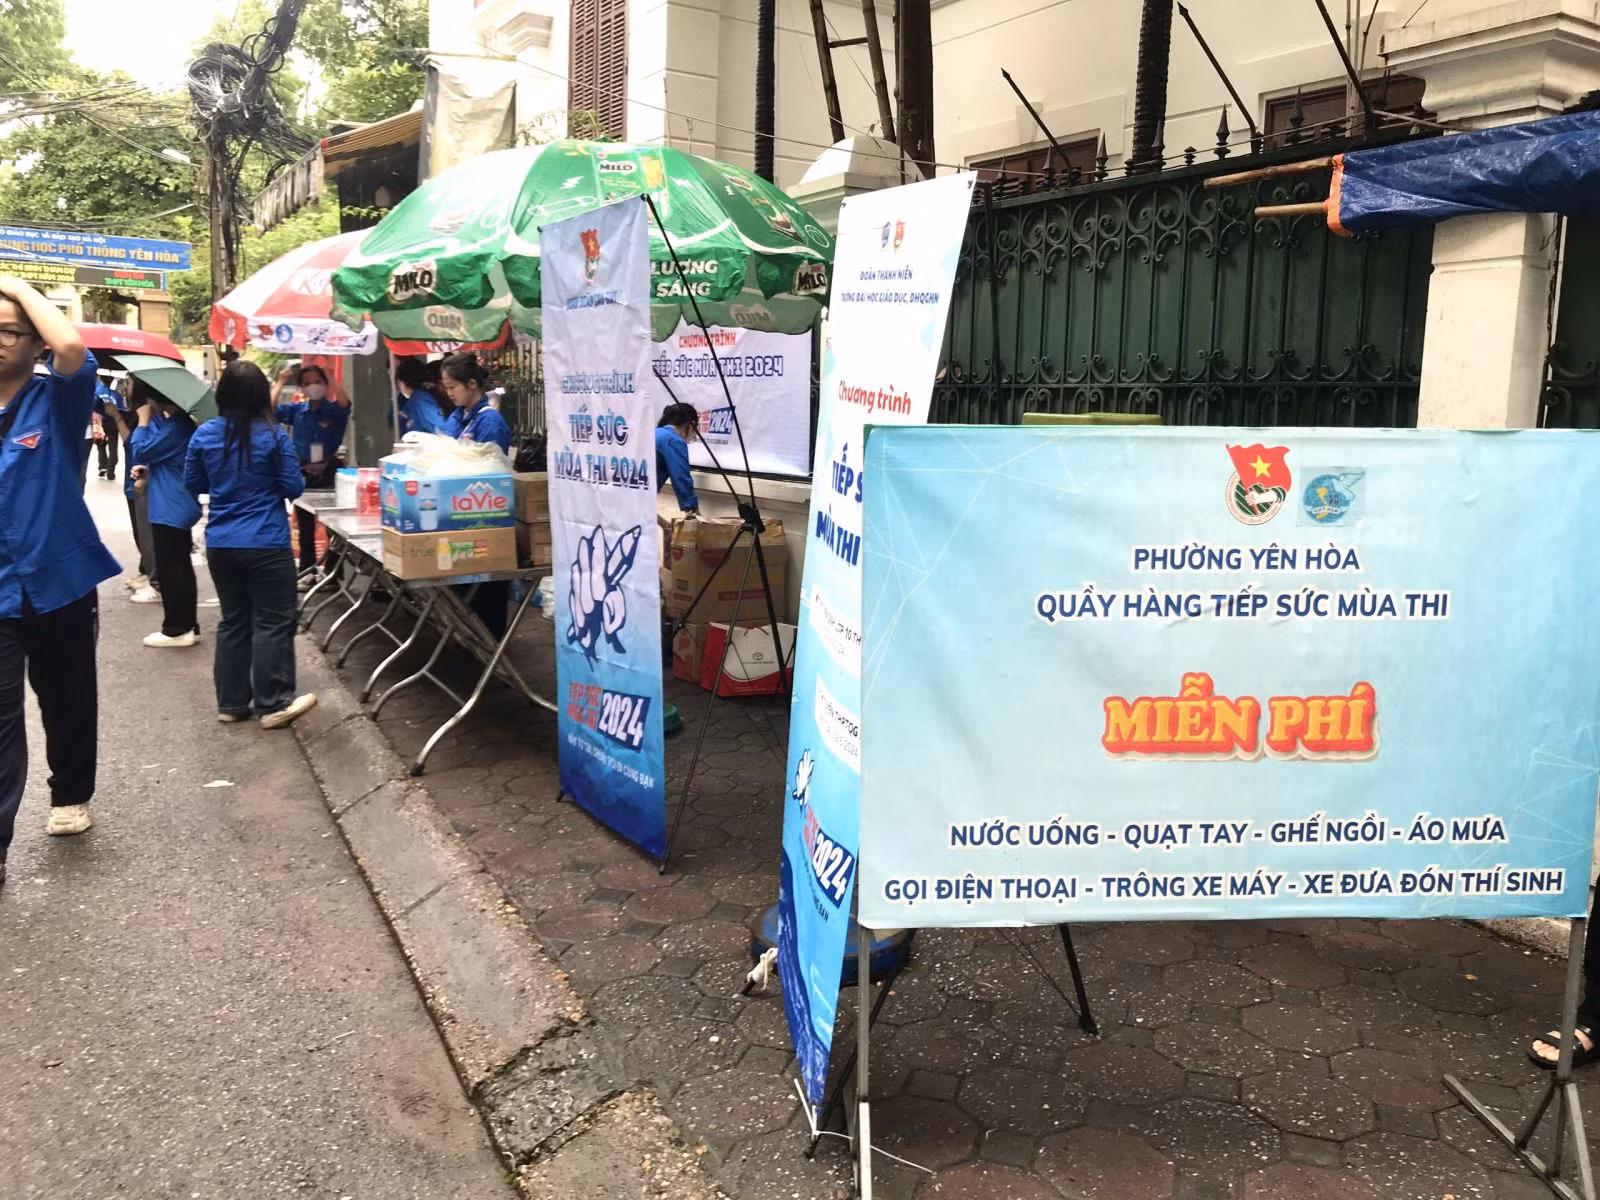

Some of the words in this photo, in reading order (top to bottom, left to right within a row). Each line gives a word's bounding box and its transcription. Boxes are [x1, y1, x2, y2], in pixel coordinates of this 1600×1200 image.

[31, 241, 57, 253] HỌC
[86, 244, 126, 259] THÔNG
[129, 247, 153, 261] YÊN
[155, 249, 179, 263] HÒA
[797, 272, 826, 291] MILO
[877, 269, 897, 280] THANH
[673, 353, 693, 378] SỨC
[694, 353, 717, 377] MÙA
[718, 356, 742, 377] THI
[745, 355, 784, 377] 2024
[838, 379, 875, 414] Chương
[877, 384, 912, 415] trình
[569, 403, 593, 443] TIẾP
[596, 407, 628, 446] SỨC
[554, 445, 584, 482] MÙA
[585, 454, 608, 485] THI
[611, 456, 649, 490] 2024
[832, 441, 854, 496] TIẾP
[816, 502, 835, 552] MÙA
[835, 525, 861, 566] THI
[1134, 543, 1242, 570] PHƯỜNG
[1249, 543, 1297, 570] YÊN
[1306, 547, 1360, 570] HÒA
[1037, 585, 1117, 622] QUẦY
[1124, 587, 1202, 617] HÀNG
[1211, 585, 1268, 617] TIẾP
[1276, 586, 1329, 617] SỨC
[1338, 586, 1397, 617] MÙA
[1405, 593, 1448, 617] THI
[599, 692, 645, 747] 2024
[1103, 673, 1260, 752] MIỄN
[1269, 682, 1376, 752] PHÍ
[951, 818, 1020, 846] NƯỚC
[1029, 816, 1099, 846] UỐNG
[1124, 823, 1193, 850] QUẠT
[1199, 823, 1249, 845] TAY
[1270, 814, 1320, 843] GHẾ
[1326, 813, 1385, 842] NGỒI
[1408, 814, 1444, 841] ÁO
[1452, 816, 1506, 841] MƯA
[813, 832, 852, 901] 2024
[884, 879, 927, 905] GỌI
[934, 873, 993, 905] ĐIỆN
[1000, 877, 1076, 904] THOẠI
[1101, 871, 1185, 898] TRÔNG
[1192, 876, 1223, 897] XE
[1229, 869, 1283, 896] MÁY
[1303, 874, 1334, 895] XE
[1339, 870, 1393, 894] ĐƯA
[1399, 867, 1453, 894] ĐÓN
[1460, 866, 1501, 893] THÍ
[1505, 870, 1563, 893] SINH
